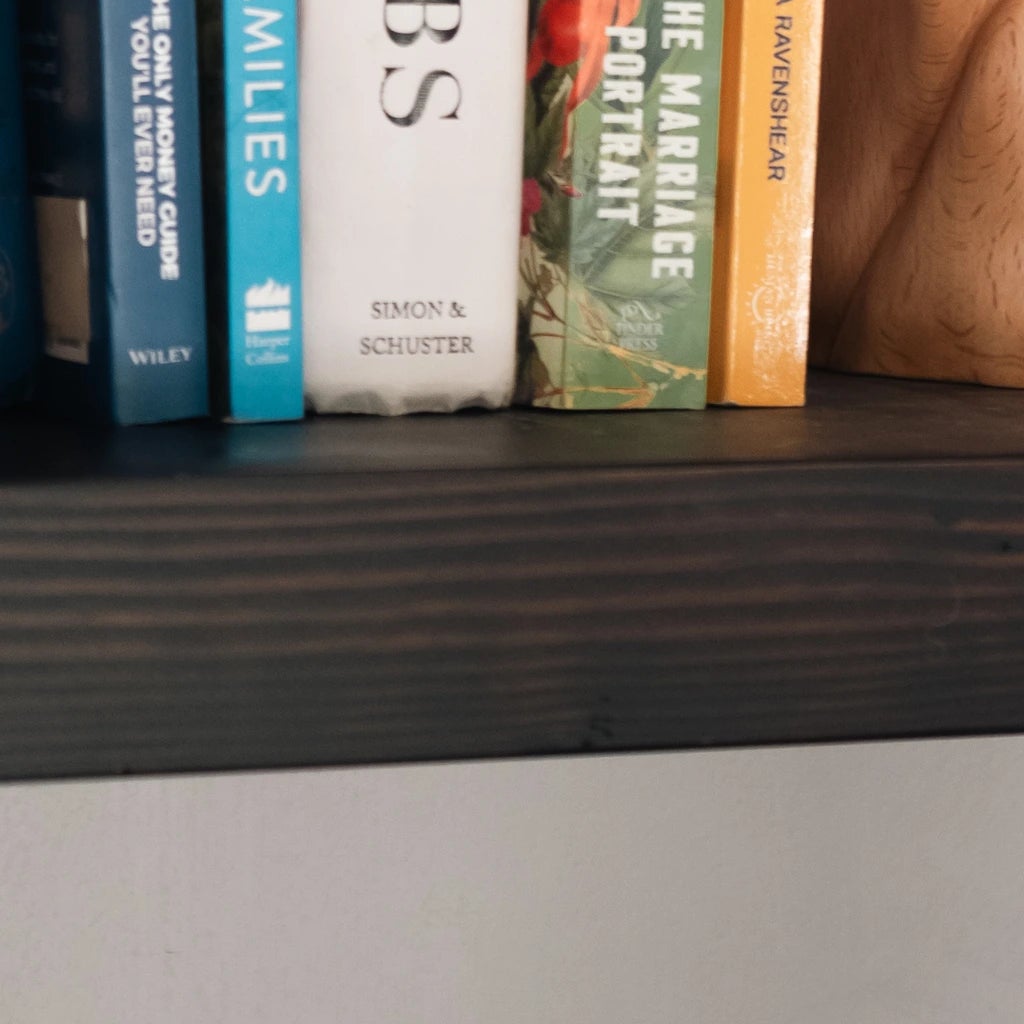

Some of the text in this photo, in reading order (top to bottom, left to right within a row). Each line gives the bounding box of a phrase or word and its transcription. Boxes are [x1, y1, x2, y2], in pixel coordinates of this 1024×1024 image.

[153, 32, 174, 103] ONLY
[766, 14, 792, 182] RAVENSHEAR
[130, 15, 158, 248] YOU'LL EVER NEED
[155, 105, 178, 198] MONEY
[597, 25, 647, 227] PORTRAIT
[651, 74, 702, 280] MARRIAGE
[158, 201, 181, 280] GUIDE
[359, 336, 475, 356] SCHUSTER
[371, 301, 467, 320] SIMON &
[128, 346, 194, 367] WILEY
